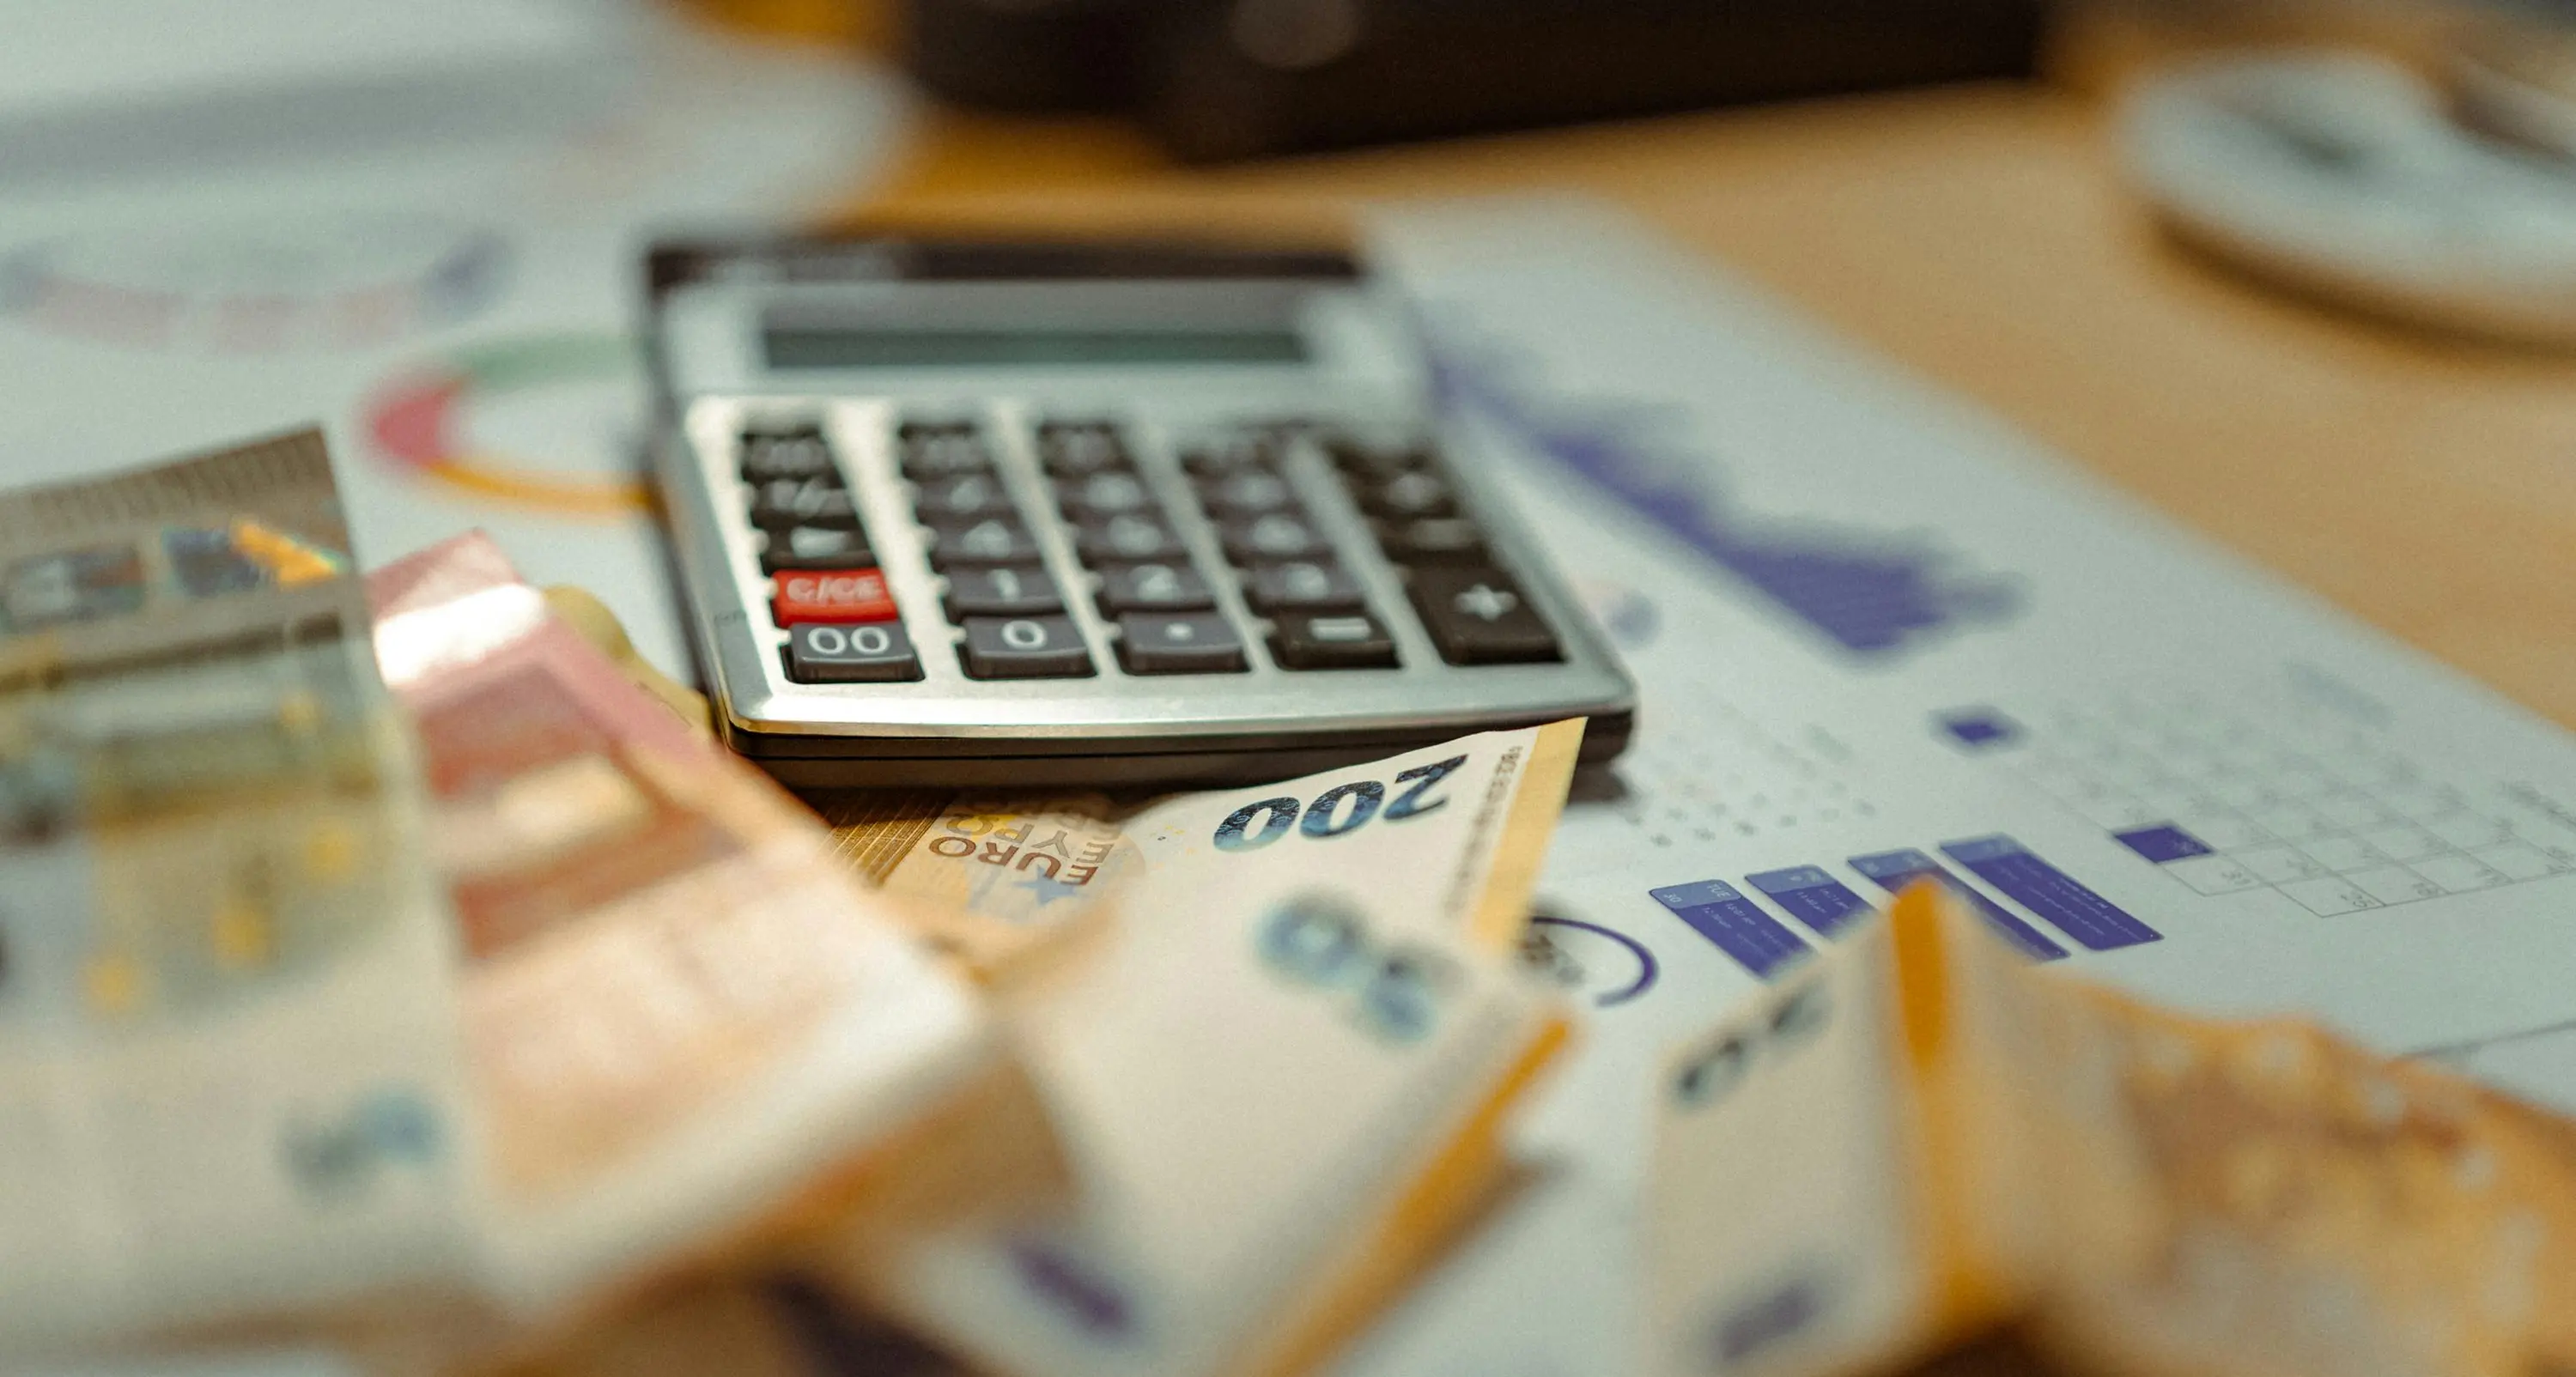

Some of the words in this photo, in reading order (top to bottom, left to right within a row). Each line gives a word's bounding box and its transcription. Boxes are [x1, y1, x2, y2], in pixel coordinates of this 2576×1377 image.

[787, 575, 883, 603] C/CE
[808, 626, 890, 656] 00
[1002, 620, 1047, 649] 0
[1213, 754, 1468, 852] 200
[929, 836, 1099, 886] EURO
